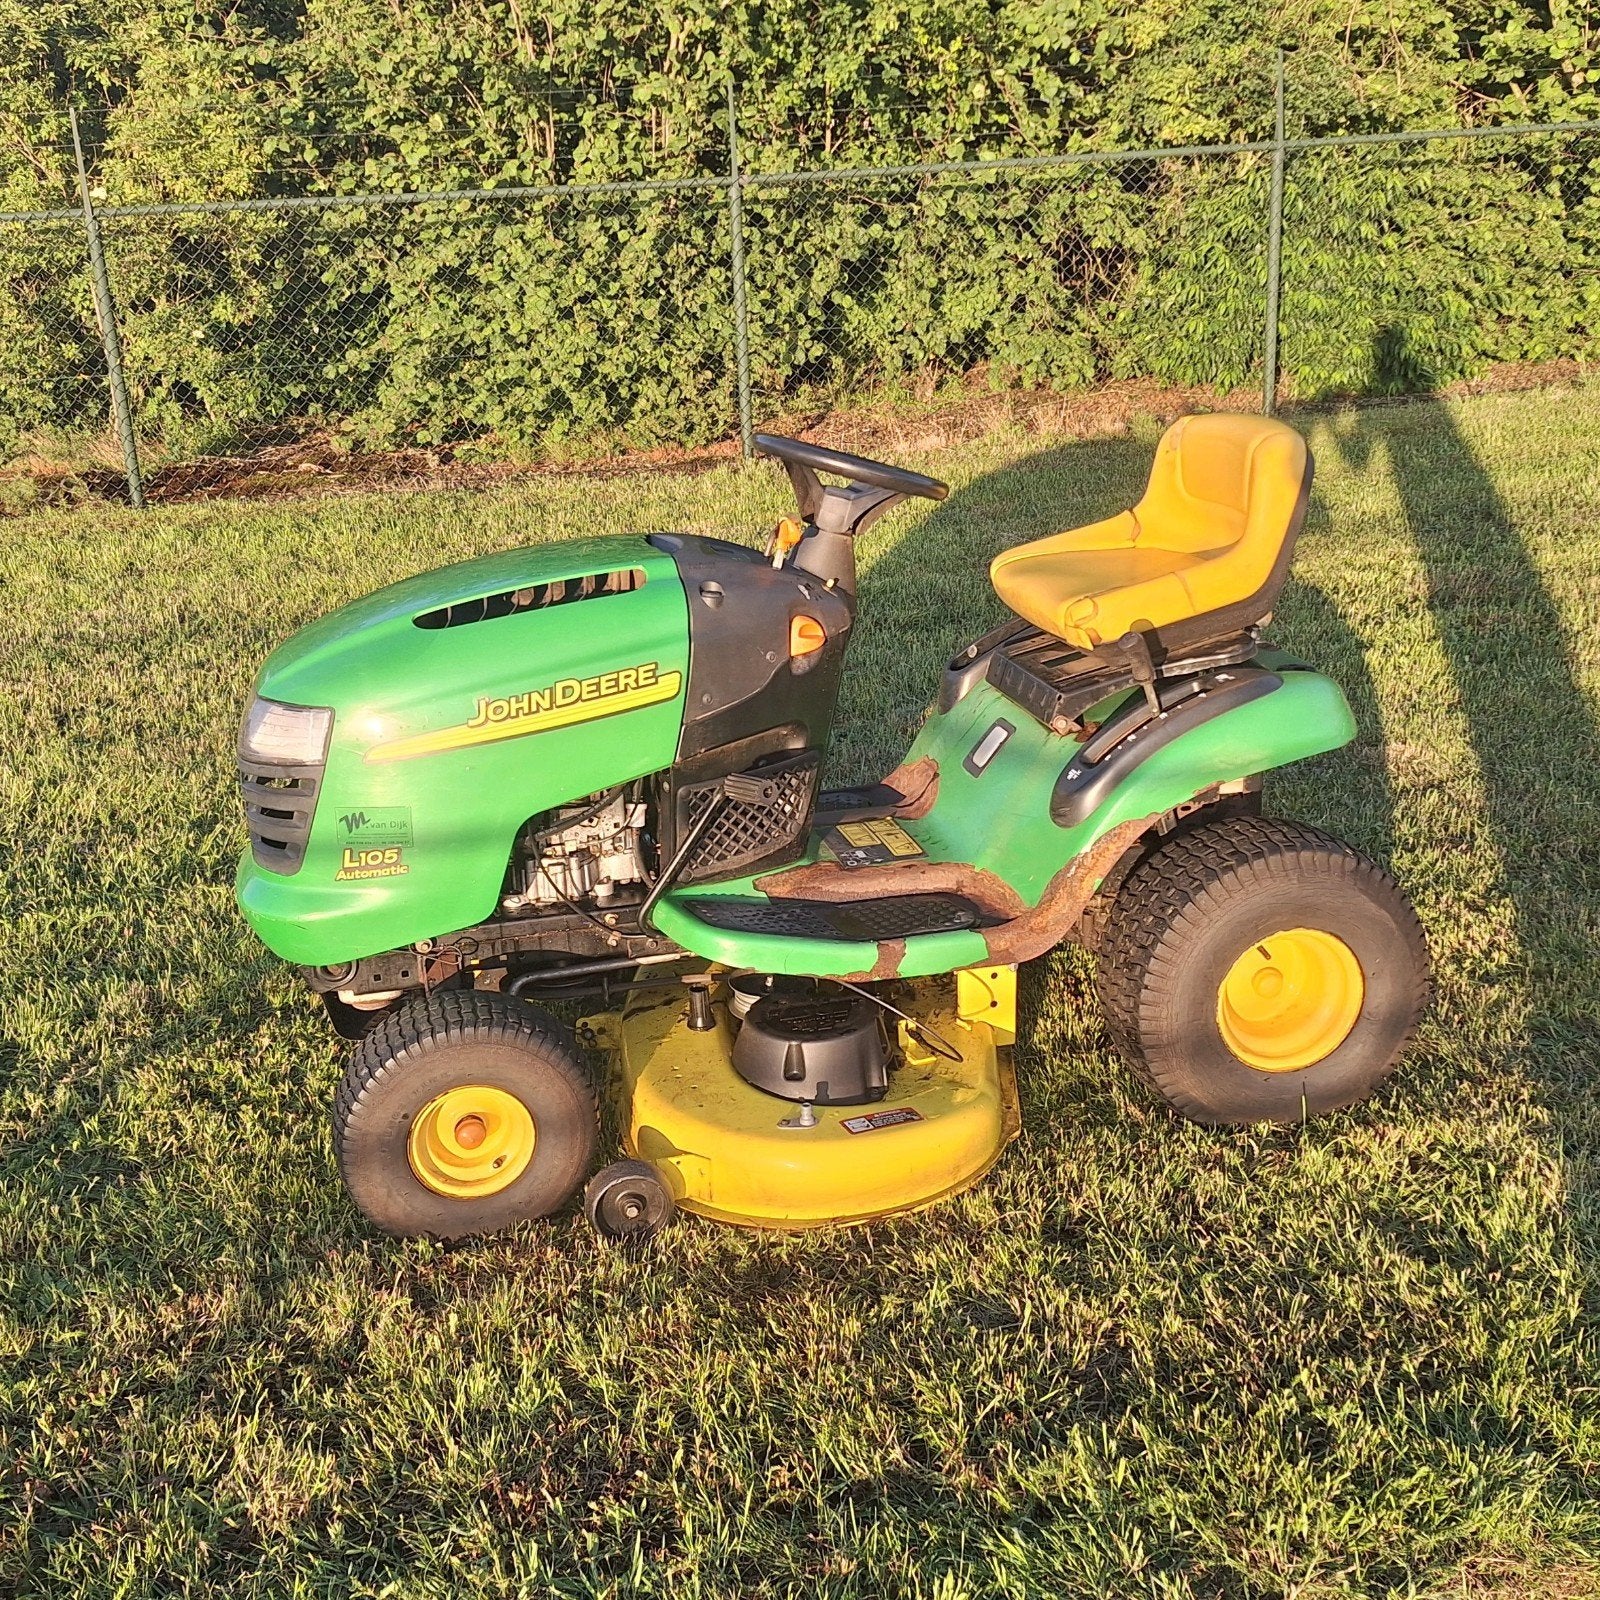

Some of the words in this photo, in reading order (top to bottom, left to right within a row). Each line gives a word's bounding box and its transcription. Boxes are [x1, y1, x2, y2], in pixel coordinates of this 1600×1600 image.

[467, 688, 552, 727] JOHN
[553, 662, 658, 708] DEERE
[390, 820, 408, 830] Dijk
[343, 848, 400, 869] L105
[335, 864, 408, 881] Automatic
